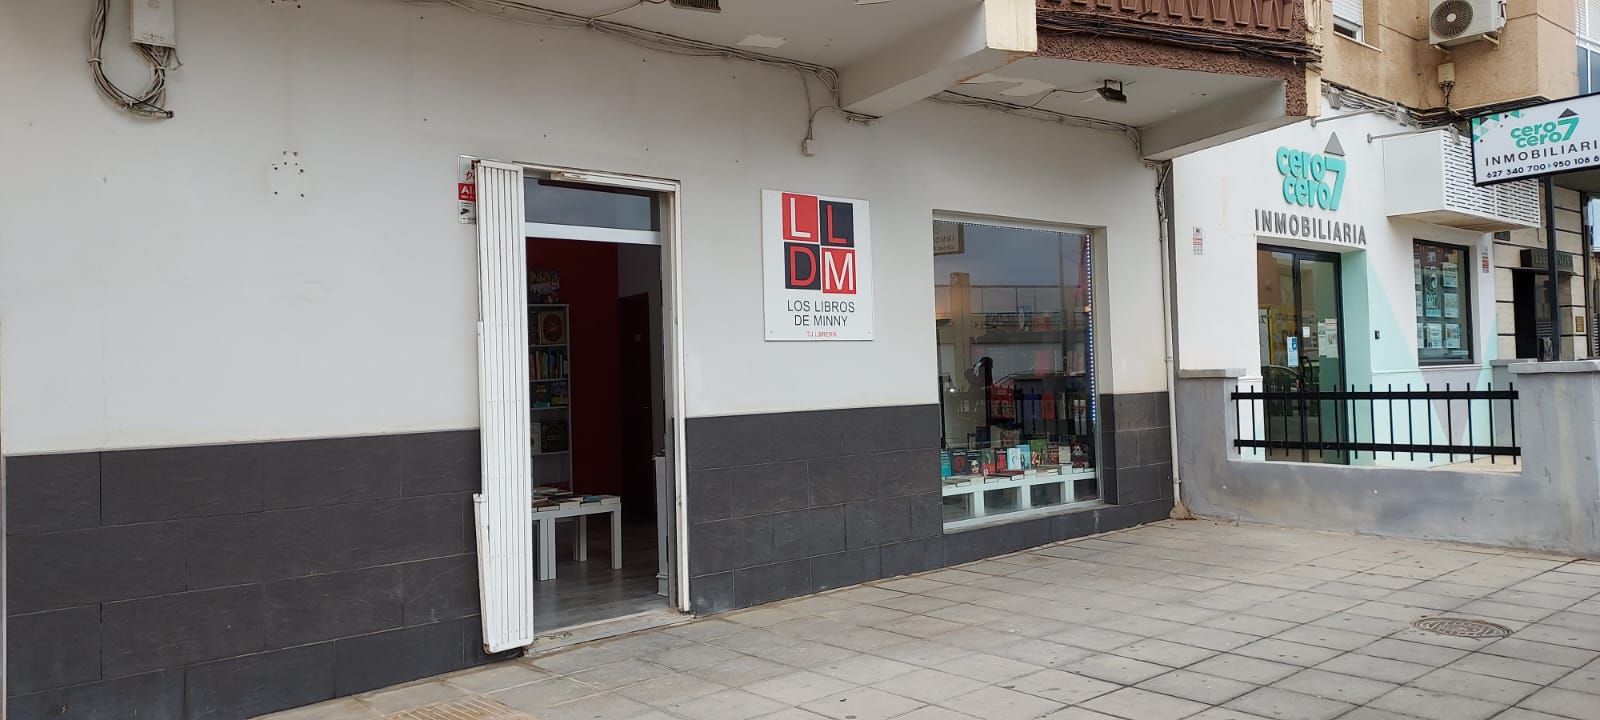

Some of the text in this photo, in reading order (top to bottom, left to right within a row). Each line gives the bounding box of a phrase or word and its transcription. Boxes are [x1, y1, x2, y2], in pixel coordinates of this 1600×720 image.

[1515, 131, 1562, 149] cero
[1276, 146, 1326, 182] cero
[1485, 139, 1598, 167] INMOBILIARI
[1487, 170, 1503, 179] 627
[1527, 163, 1546, 172] 700
[1552, 160, 1571, 168] 950
[1282, 175, 1332, 211] cero
[1254, 208, 1367, 246] INMOBILIARIA
[787, 299, 855, 314] LOS LIBROS
[794, 314, 848, 327] DE MINNY
